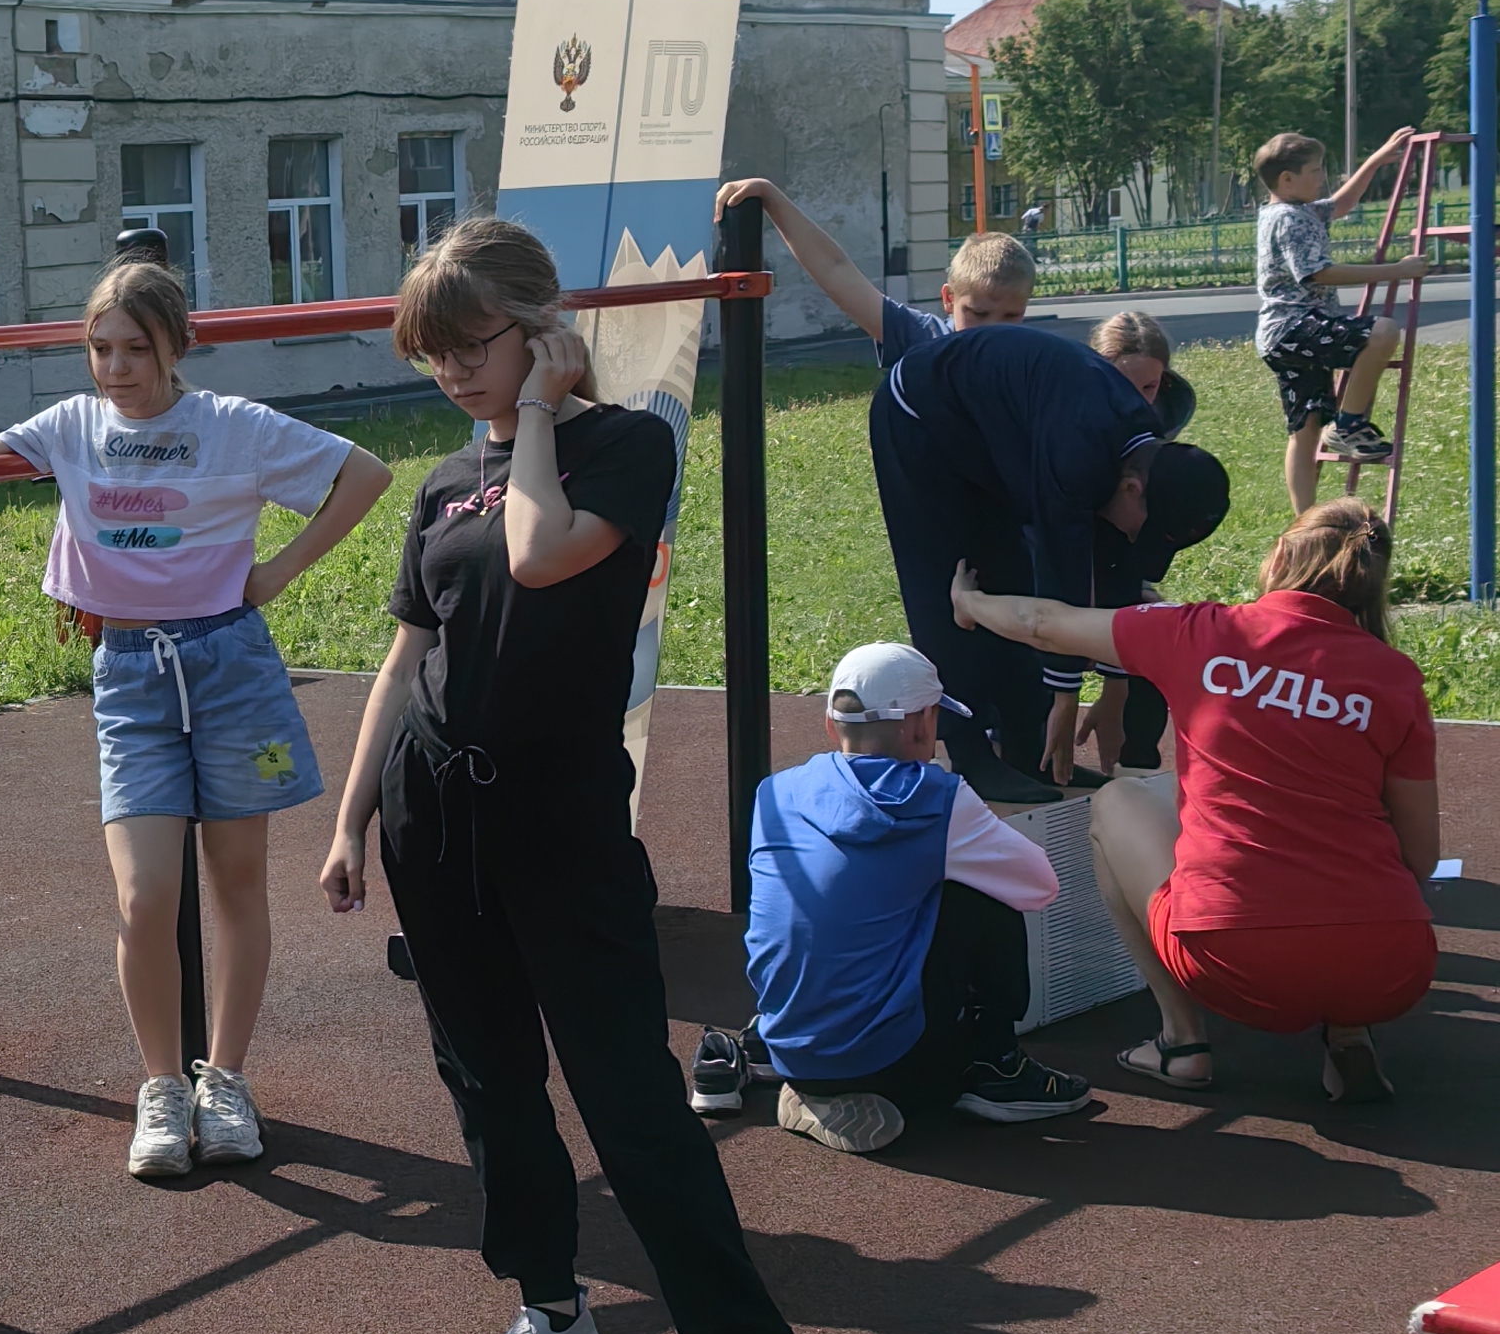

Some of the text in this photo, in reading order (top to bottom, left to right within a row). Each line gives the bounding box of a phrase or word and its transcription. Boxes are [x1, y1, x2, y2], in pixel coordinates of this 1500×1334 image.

[524, 122, 607, 133] МИНИСТЕРСТВО СПОРТА
[104, 436, 190, 461] Summer
[95, 491, 166, 513] #Vibes
[111, 527, 157, 548] #Me
[1202, 655, 1373, 732] СУДЬЯ
